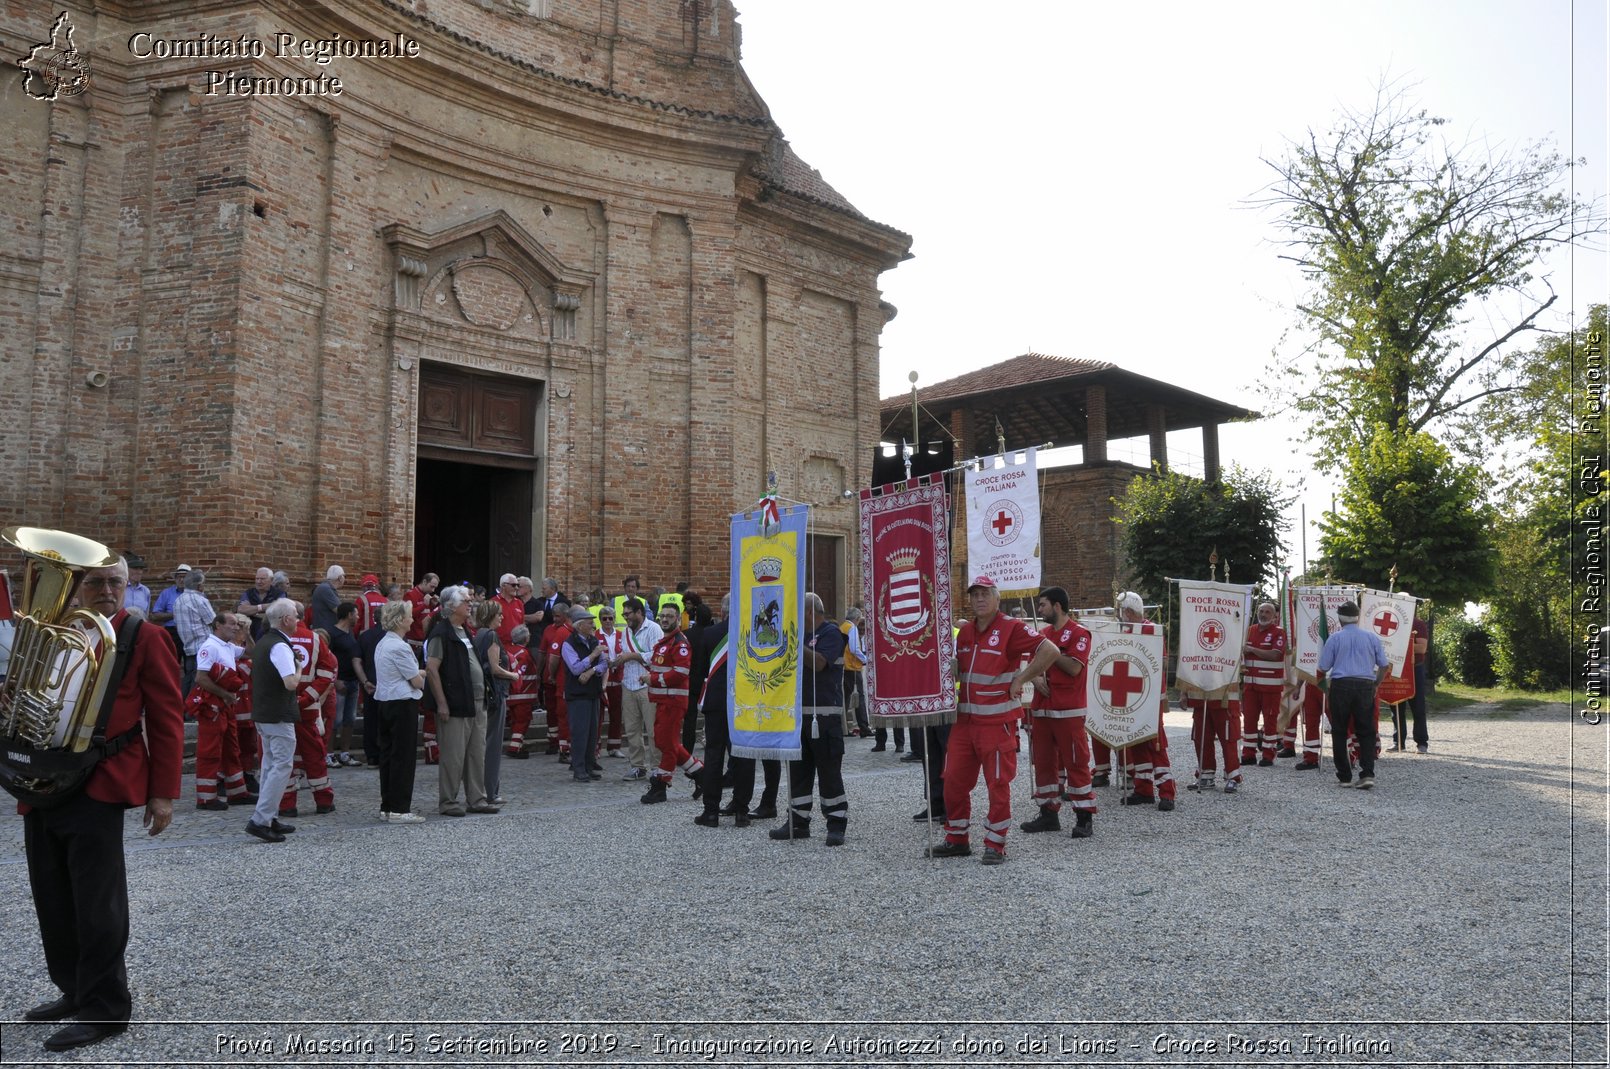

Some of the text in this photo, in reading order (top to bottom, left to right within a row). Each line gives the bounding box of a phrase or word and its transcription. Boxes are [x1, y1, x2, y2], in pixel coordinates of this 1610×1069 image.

[975, 470, 1026, 486] CROCE ROSSA
[984, 481, 1017, 493] ITALIANA
[981, 558, 1028, 570] CASTELNUOVO
[1000, 567, 1024, 575] BOSCO
[1003, 574, 1035, 582] MASSAIA
[1186, 596, 1240, 608] CROCE ROSSA
[1194, 605, 1232, 615] ITALIANA
[1088, 638, 1160, 674] CROCE ROSSA ITALIANA
[1182, 655, 1236, 667] COMITATO LOCALE
[1201, 664, 1224, 672] CANELLI
[1102, 714, 1135, 724] COMITATO
[1087, 716, 1125, 743] VILLANOVA
[1104, 723, 1131, 733] LOCALE
[8, 751, 31, 764] YAMAHA
